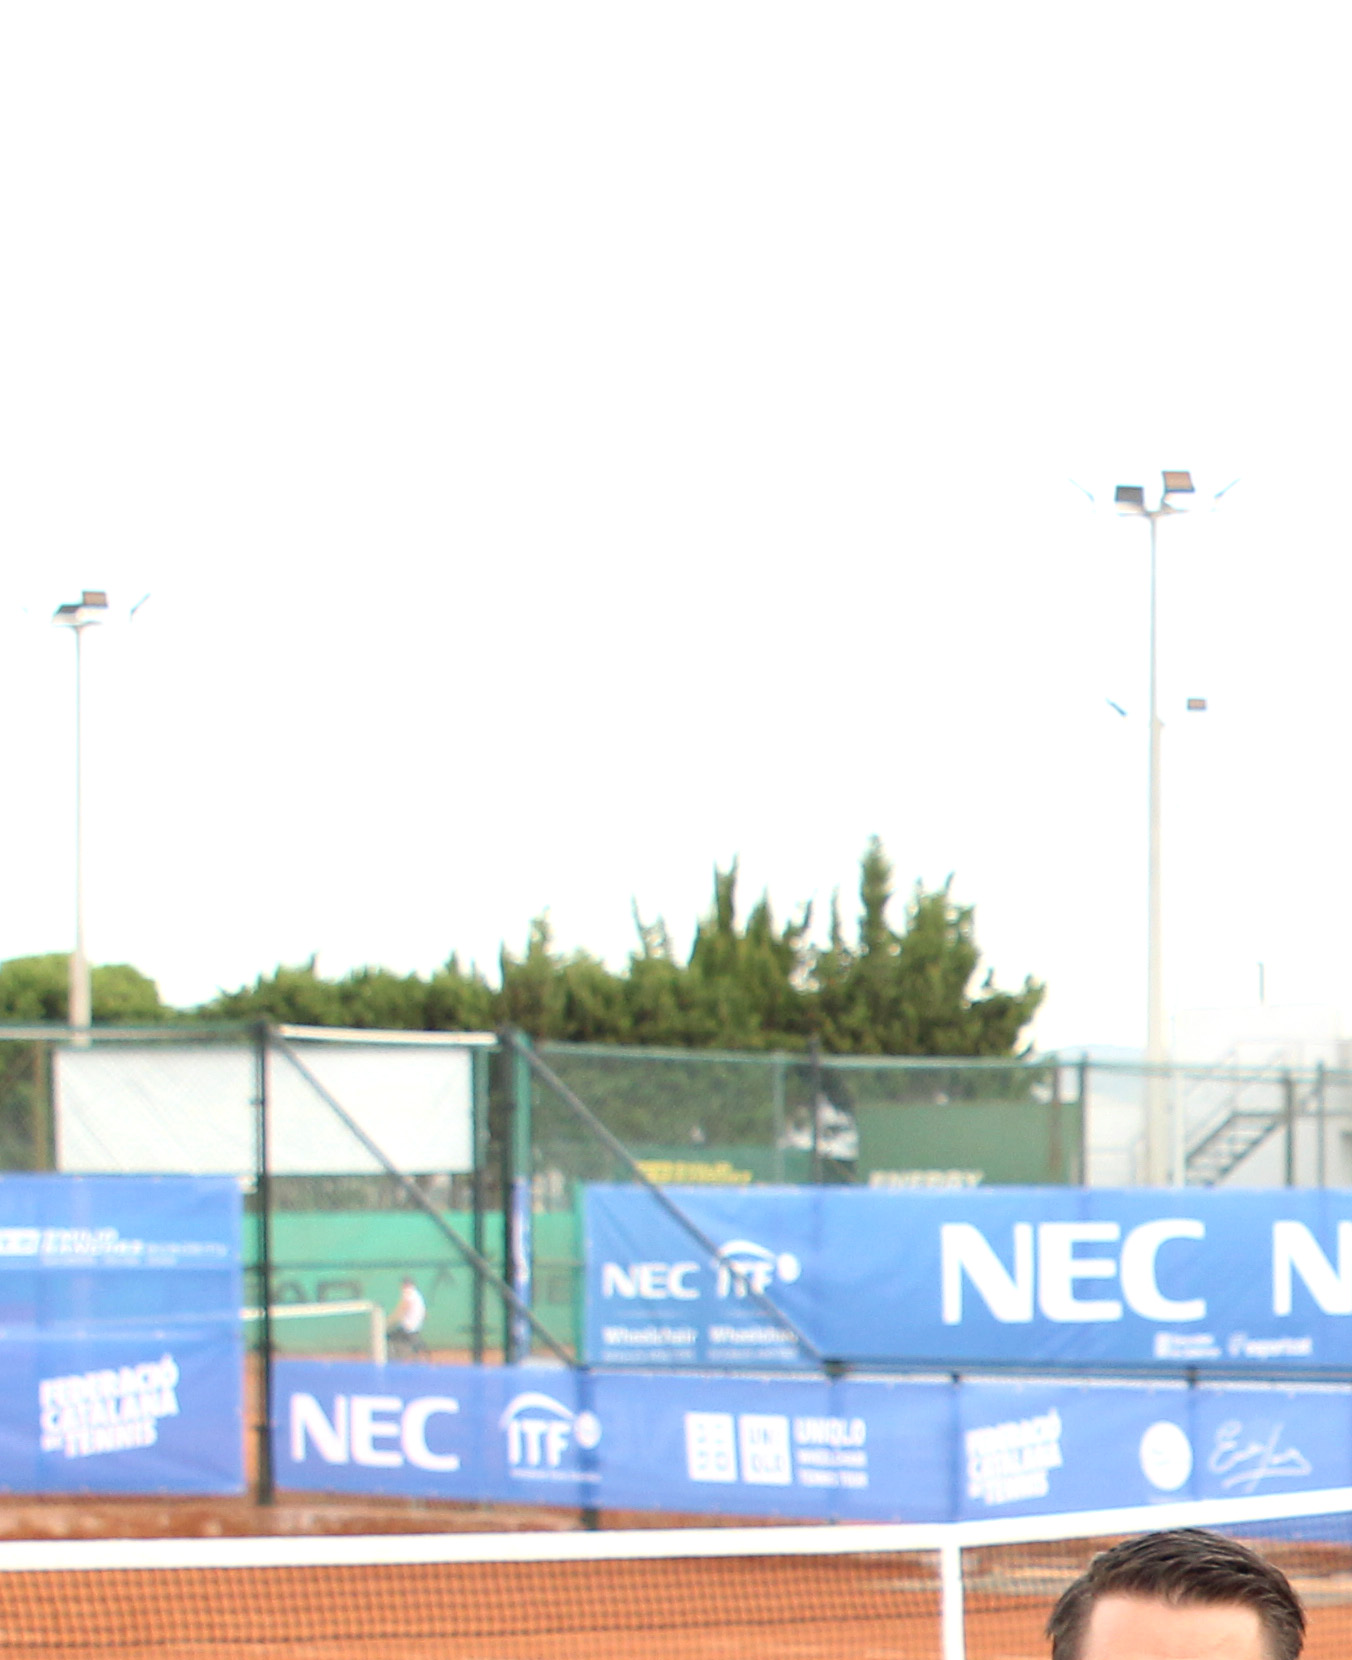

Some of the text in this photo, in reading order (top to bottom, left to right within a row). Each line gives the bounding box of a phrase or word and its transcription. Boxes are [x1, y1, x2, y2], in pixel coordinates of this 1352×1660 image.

[602, 1262, 701, 1299] NEC
[939, 1218, 1206, 1325] NEC
[290, 1392, 460, 1471] NEC
[507, 1420, 570, 1467] ITF
[793, 1416, 867, 1446] UNIQLO
